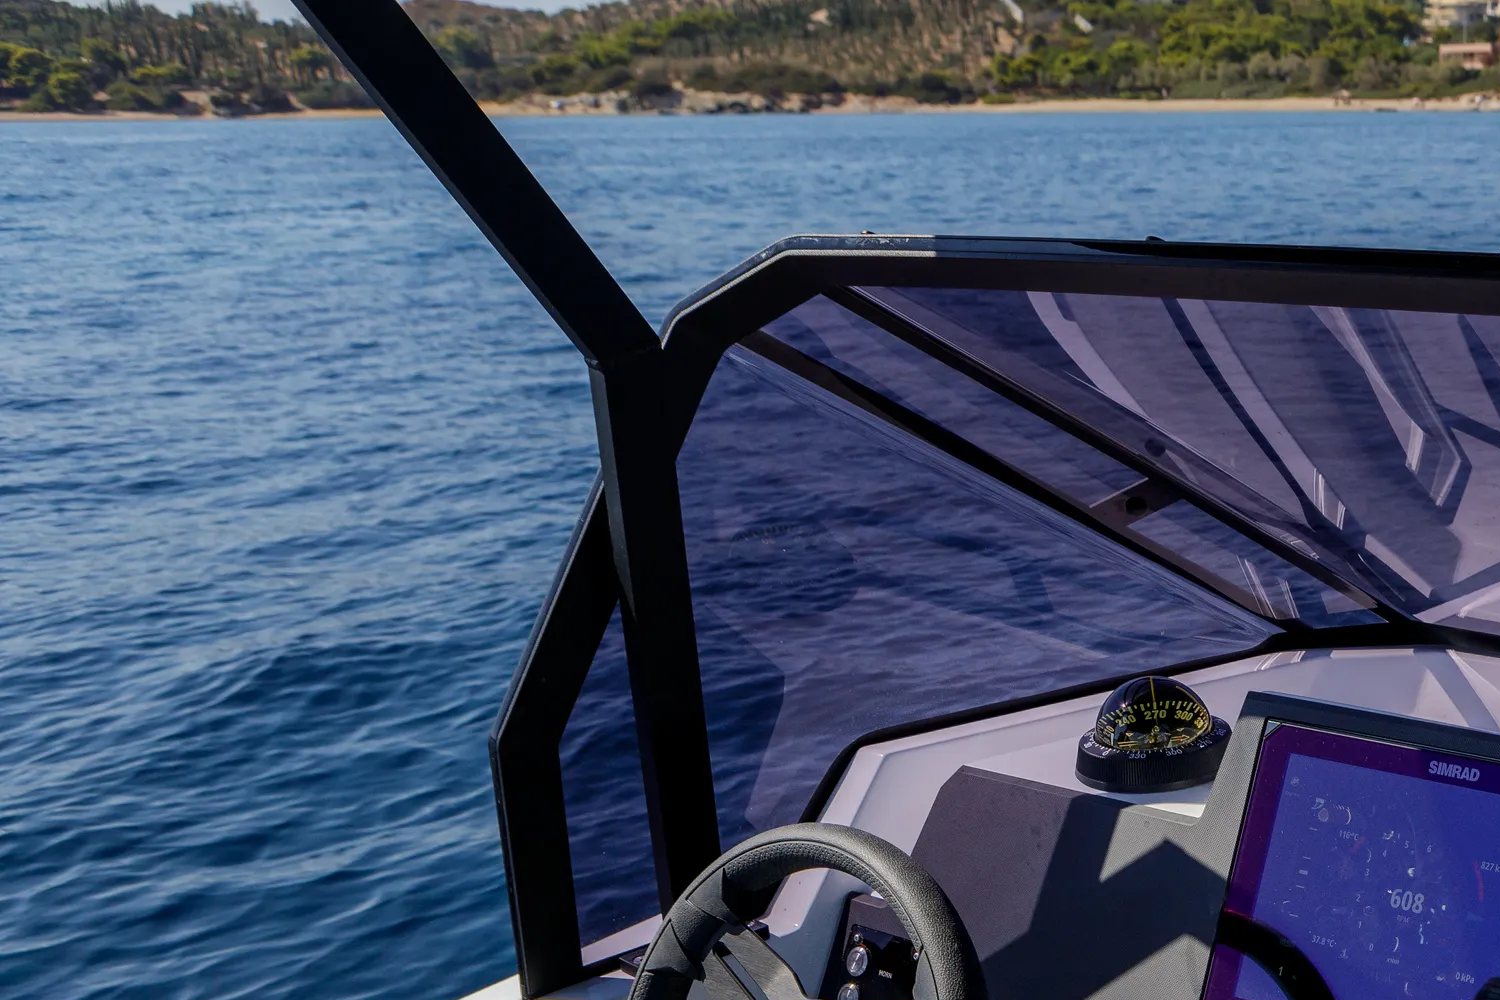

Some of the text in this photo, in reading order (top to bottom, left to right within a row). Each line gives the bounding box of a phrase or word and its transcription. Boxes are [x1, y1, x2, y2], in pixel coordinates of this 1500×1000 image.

[1144, 710, 1167, 720] 270
[1174, 710, 1194, 721] 300
[1115, 714, 1136, 728] 240
[1428, 760, 1480, 782] SIMRAD
[1480, 861, 1494, 872] 827
[1390, 889, 1425, 913] 608
[878, 969, 893, 979] HORN
